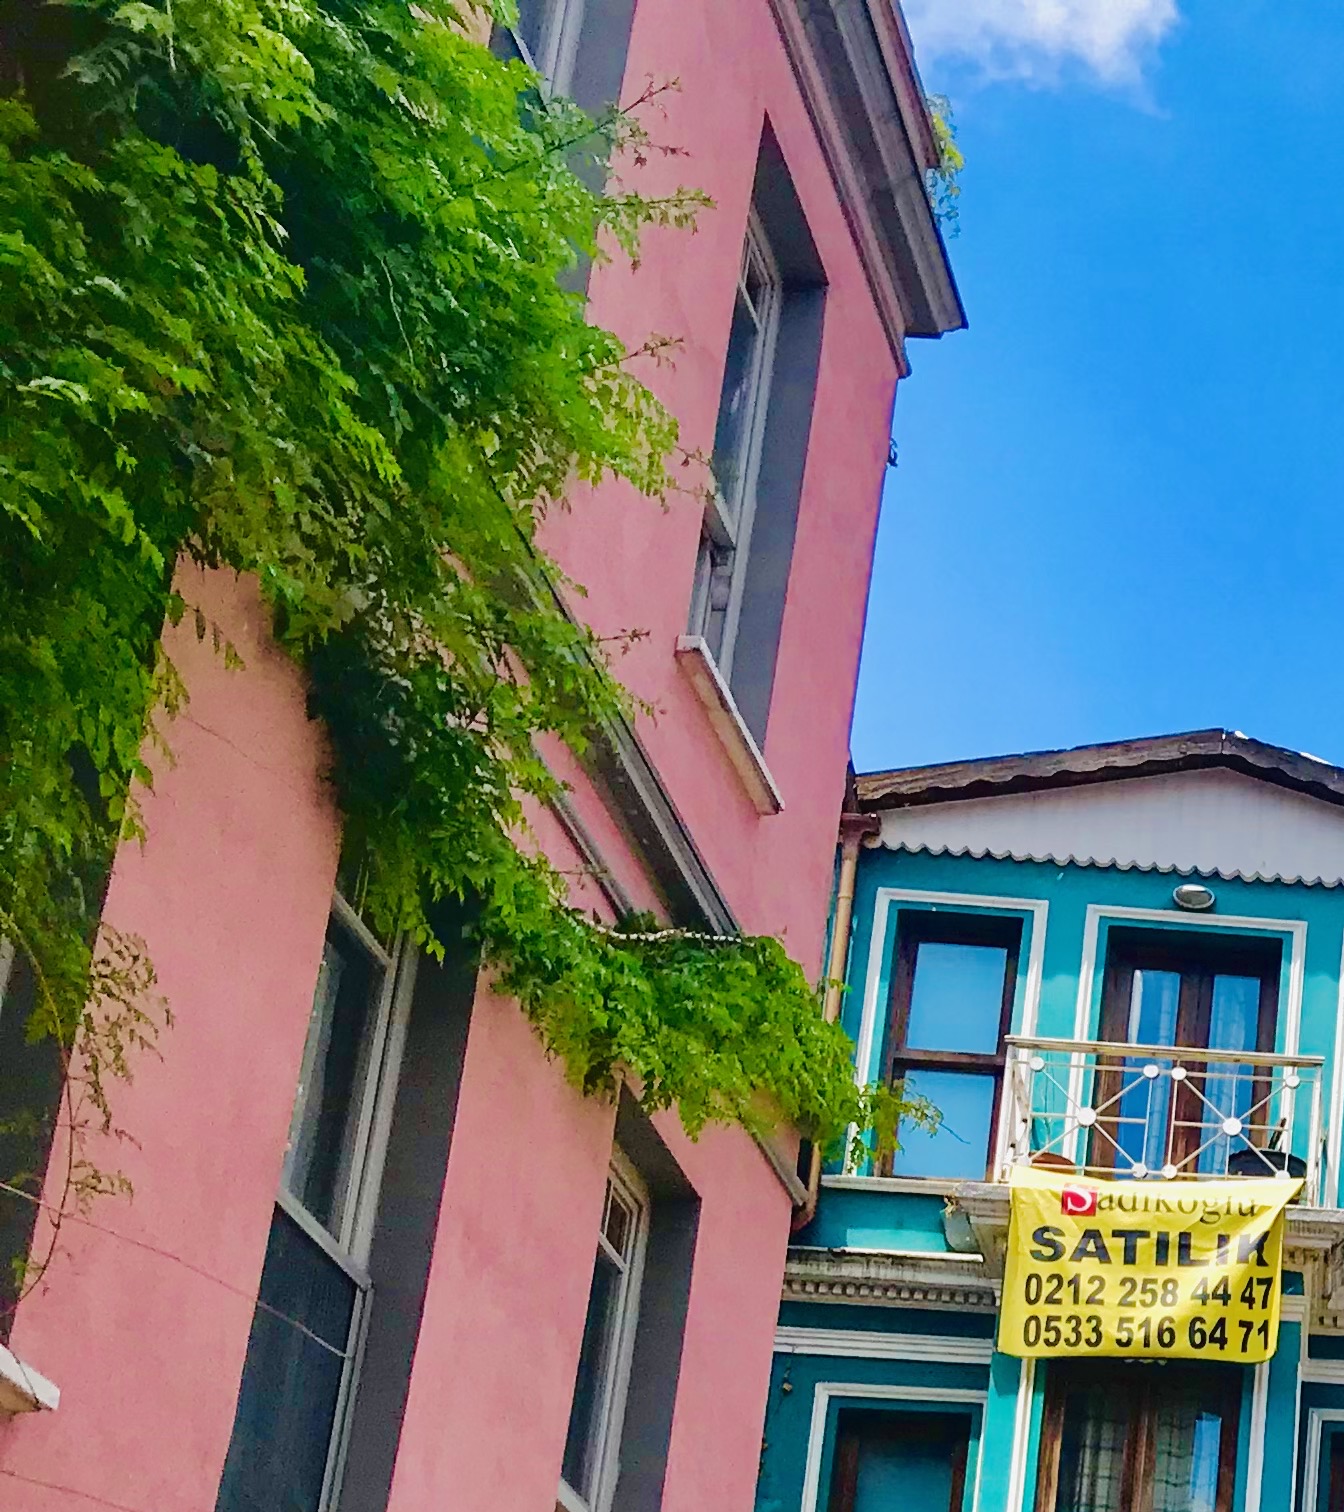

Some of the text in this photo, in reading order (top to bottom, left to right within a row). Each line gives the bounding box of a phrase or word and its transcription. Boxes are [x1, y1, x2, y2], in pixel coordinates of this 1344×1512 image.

[1029, 1226, 1271, 1268] SATILIK
[1024, 1273, 1274, 1310] 0212 258 44 47
[1023, 1314, 1269, 1353] 0533 516 64 71
